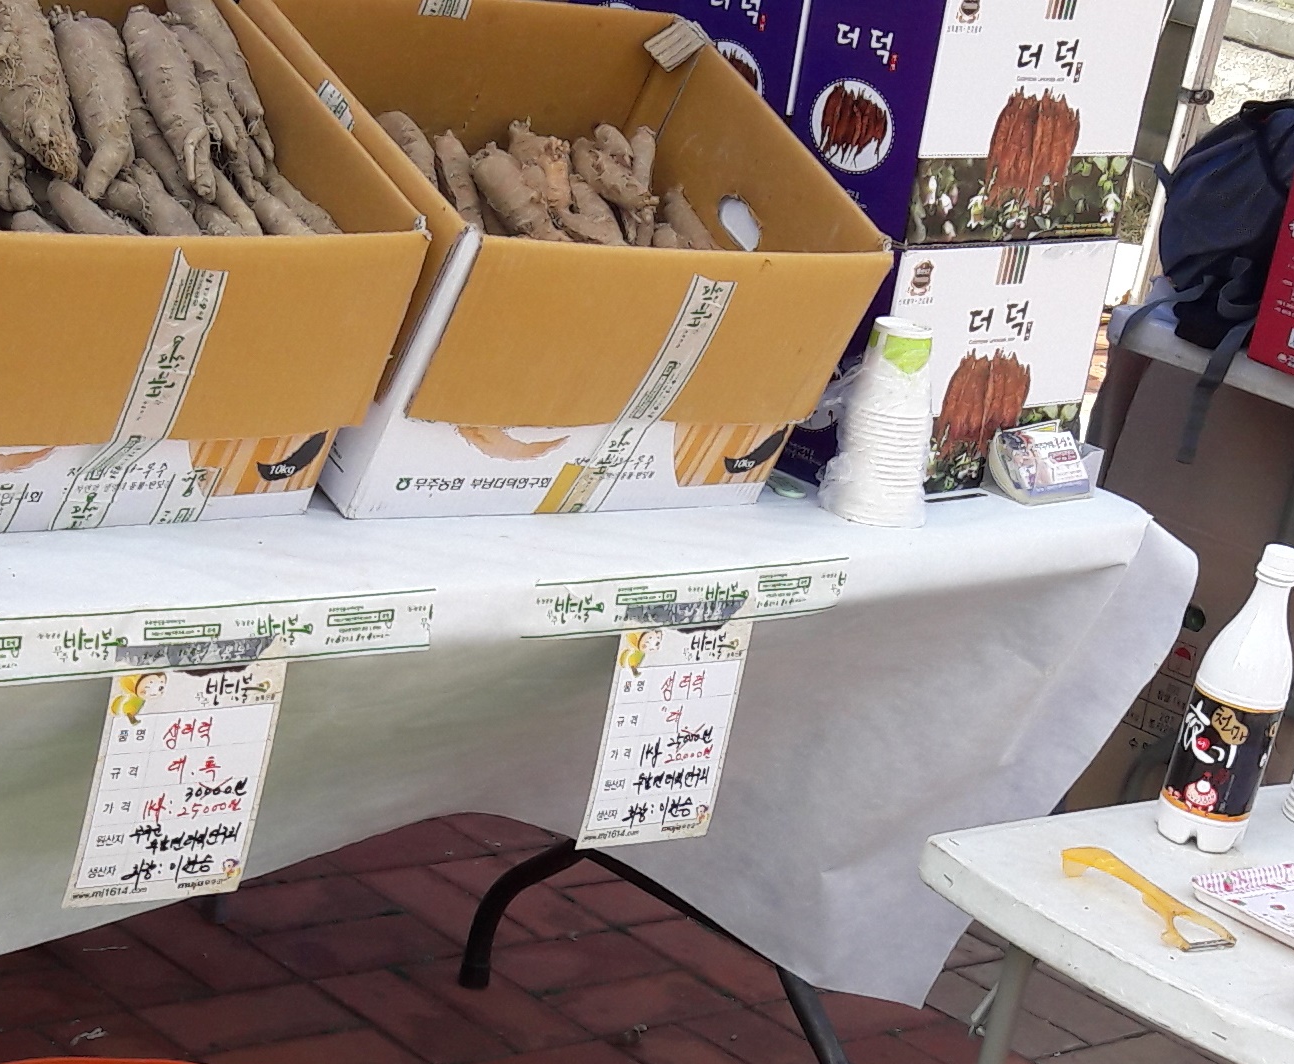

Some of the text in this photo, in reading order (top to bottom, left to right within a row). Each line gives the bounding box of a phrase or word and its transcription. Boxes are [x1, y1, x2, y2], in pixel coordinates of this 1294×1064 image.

[269, 465, 296, 476] 10kg
[413, 477, 465, 492] 무주농협
[206, 673, 271, 706] 반딧불
[1215, 706, 1248, 742] 천마
[96, 834, 124, 846] 원산지
[87, 866, 117, 878] 생산자
